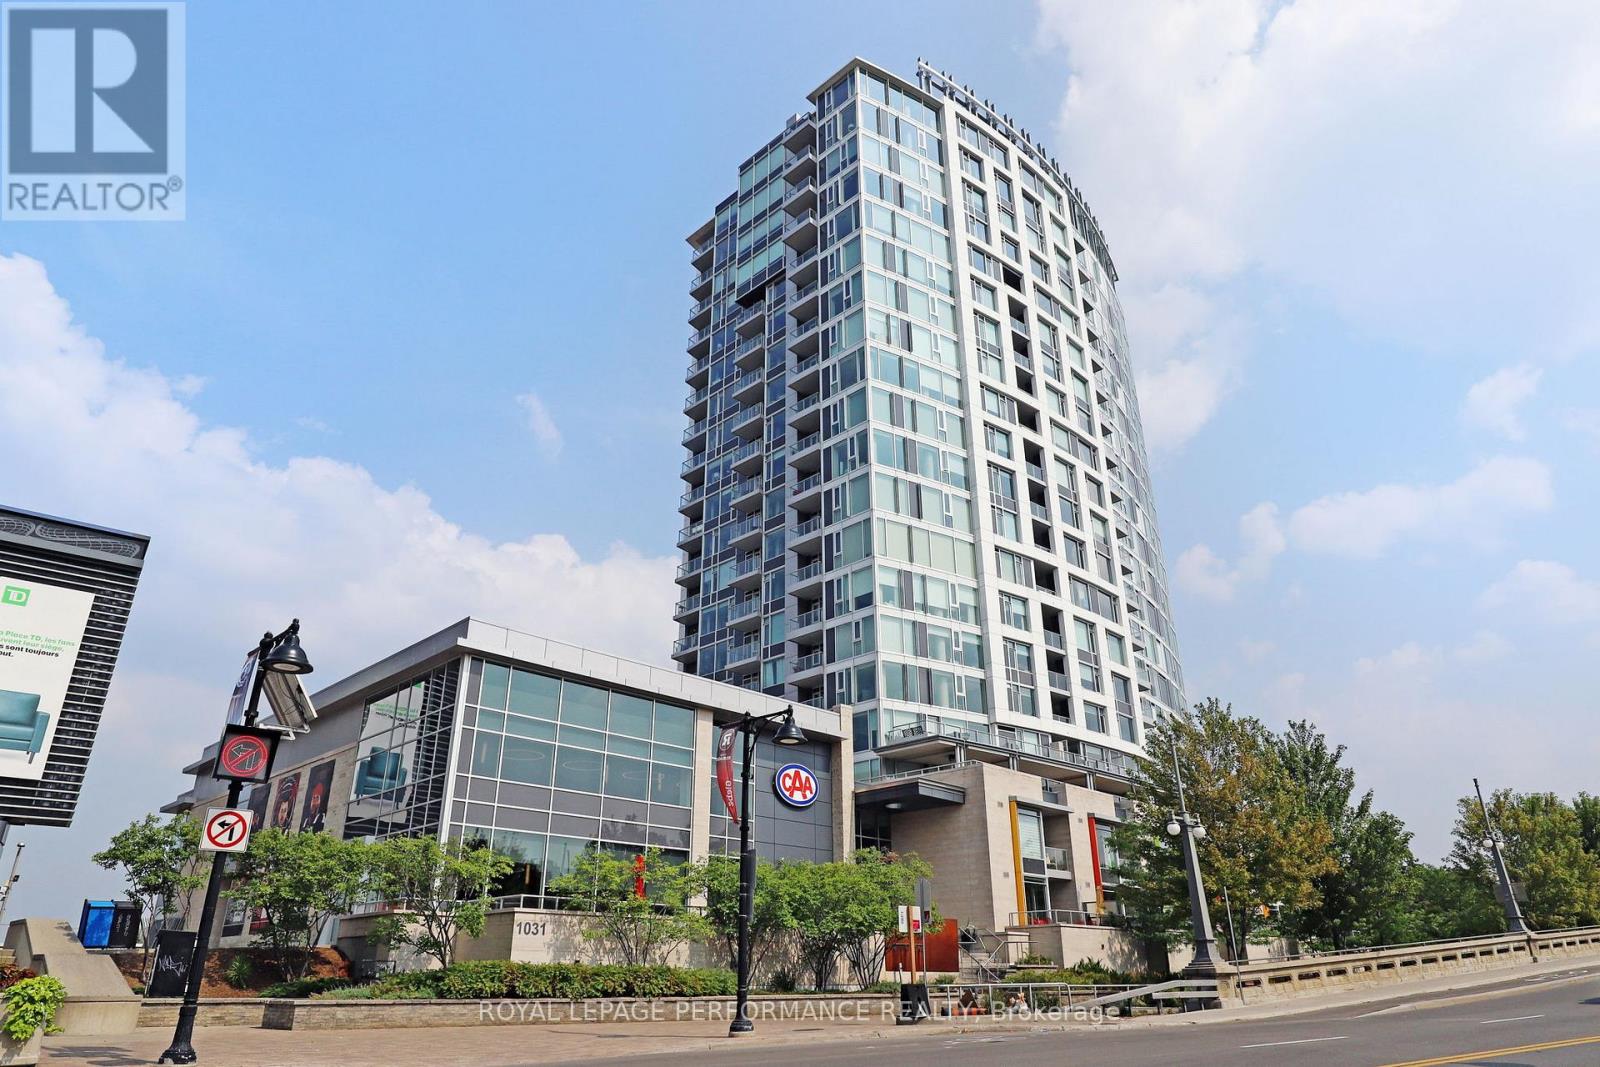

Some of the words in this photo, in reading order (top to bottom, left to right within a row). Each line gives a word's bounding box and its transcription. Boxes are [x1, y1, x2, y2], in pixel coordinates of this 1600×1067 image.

[7, 589, 27, 602] TD
[5, 630, 29, 639] Place
[30, 634, 43, 643] TD,
[44, 636, 57, 644] les
[57, 639, 75, 647] fans
[22, 640, 40, 648] leur
[25, 647, 60, 657] toujours
[781, 770, 814, 800] CAA
[516, 921, 547, 937] 1031
